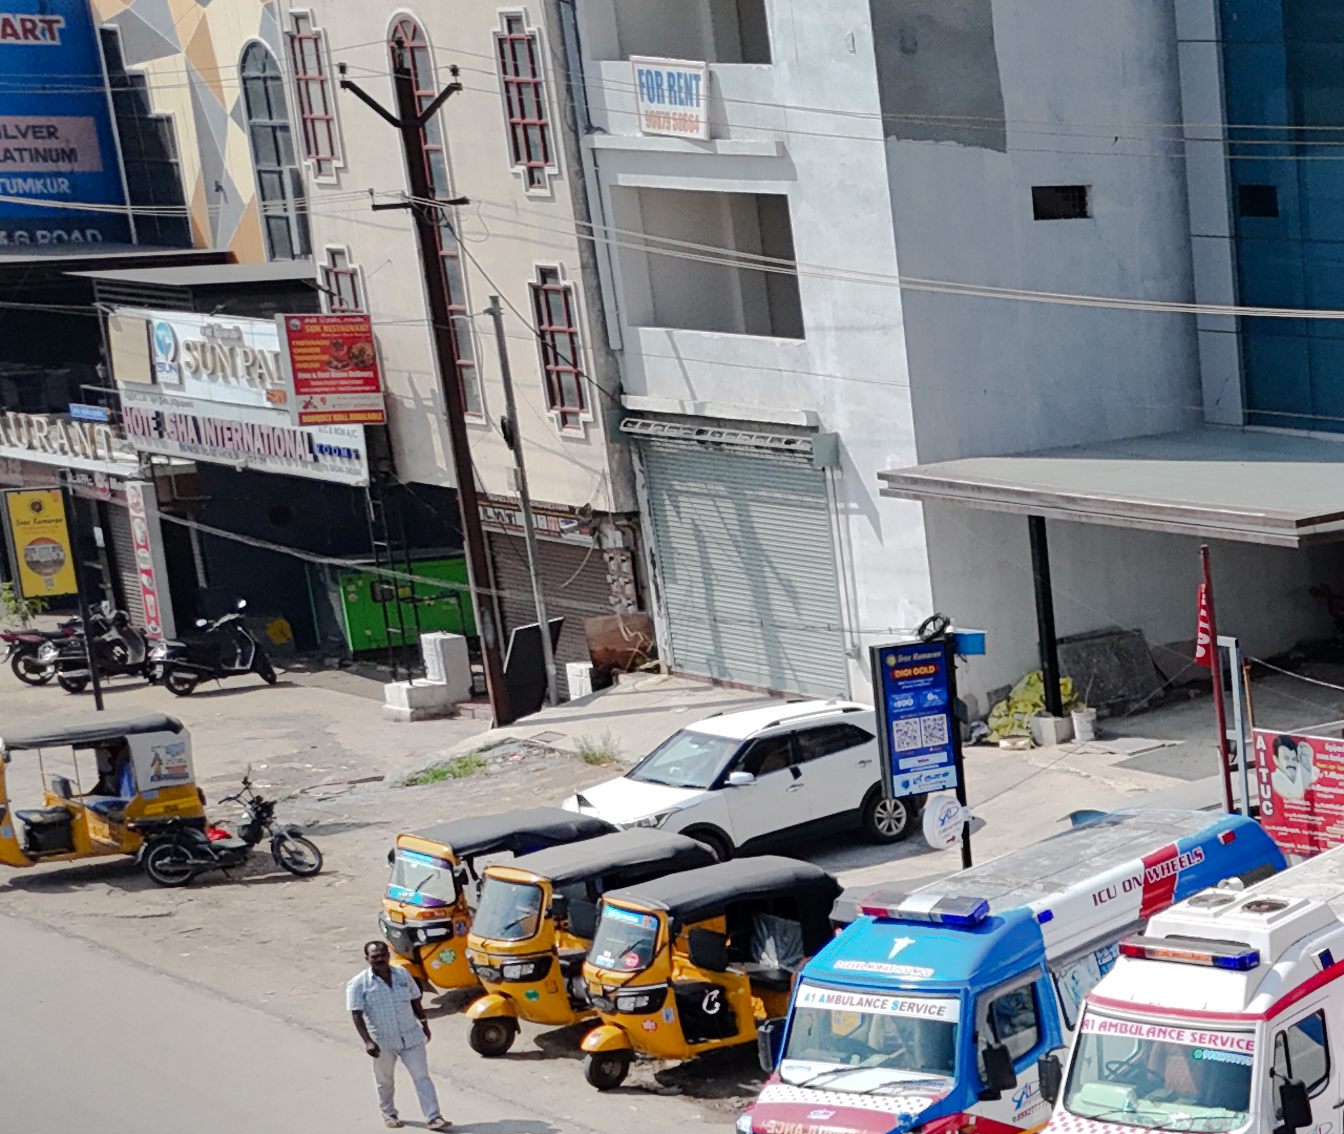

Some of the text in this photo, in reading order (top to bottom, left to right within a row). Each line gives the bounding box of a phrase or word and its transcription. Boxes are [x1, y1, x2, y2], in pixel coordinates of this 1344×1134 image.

[638, 68, 701, 108] FOR RENT
[183, 339, 236, 378] SUN
[895, 665, 935, 678] DIGI GOLD
[1255, 735, 1274, 817] AITUC
[1092, 846, 1205, 906] ICU ON WHEELS
[818, 993, 889, 1010] AMBULANCE
[891, 999, 947, 1017] SERVICE
[1098, 1020, 1185, 1042] AMBULANCE
[1190, 1031, 1255, 1050] SERVICE
